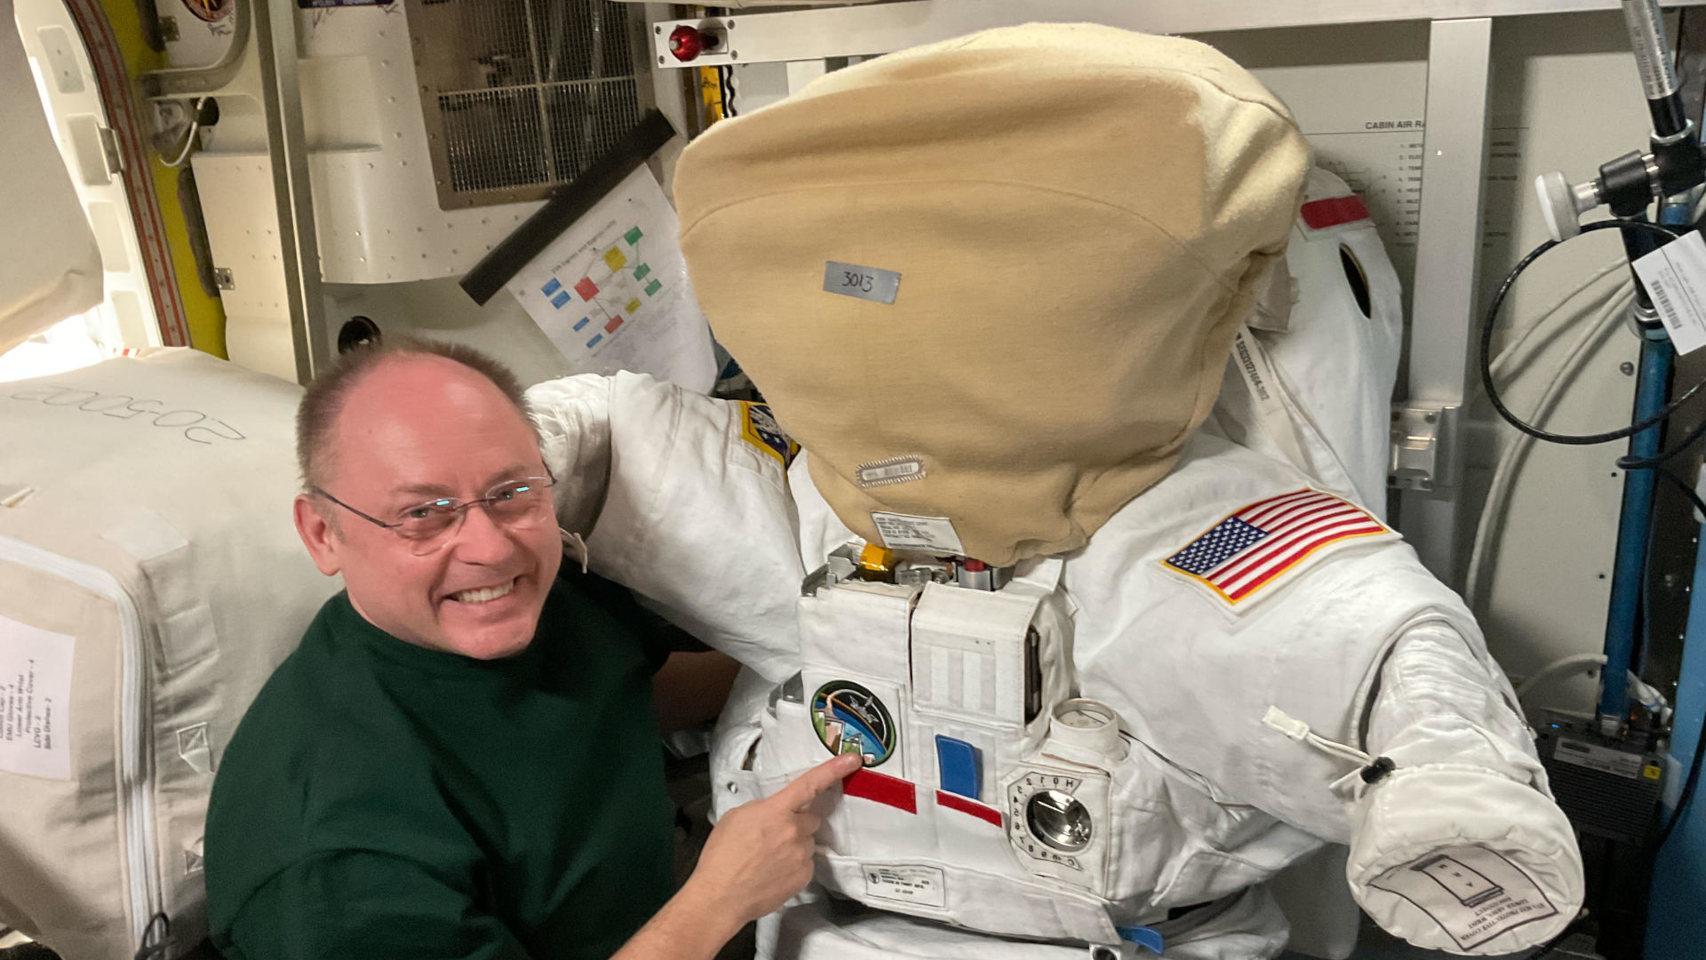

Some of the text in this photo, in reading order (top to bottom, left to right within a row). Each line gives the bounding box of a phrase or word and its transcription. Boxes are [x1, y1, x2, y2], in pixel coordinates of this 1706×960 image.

[1365, 121, 1394, 130] CABIN
[1396, 120, 1412, 128] AIR
[842, 271, 874, 292] 3013
